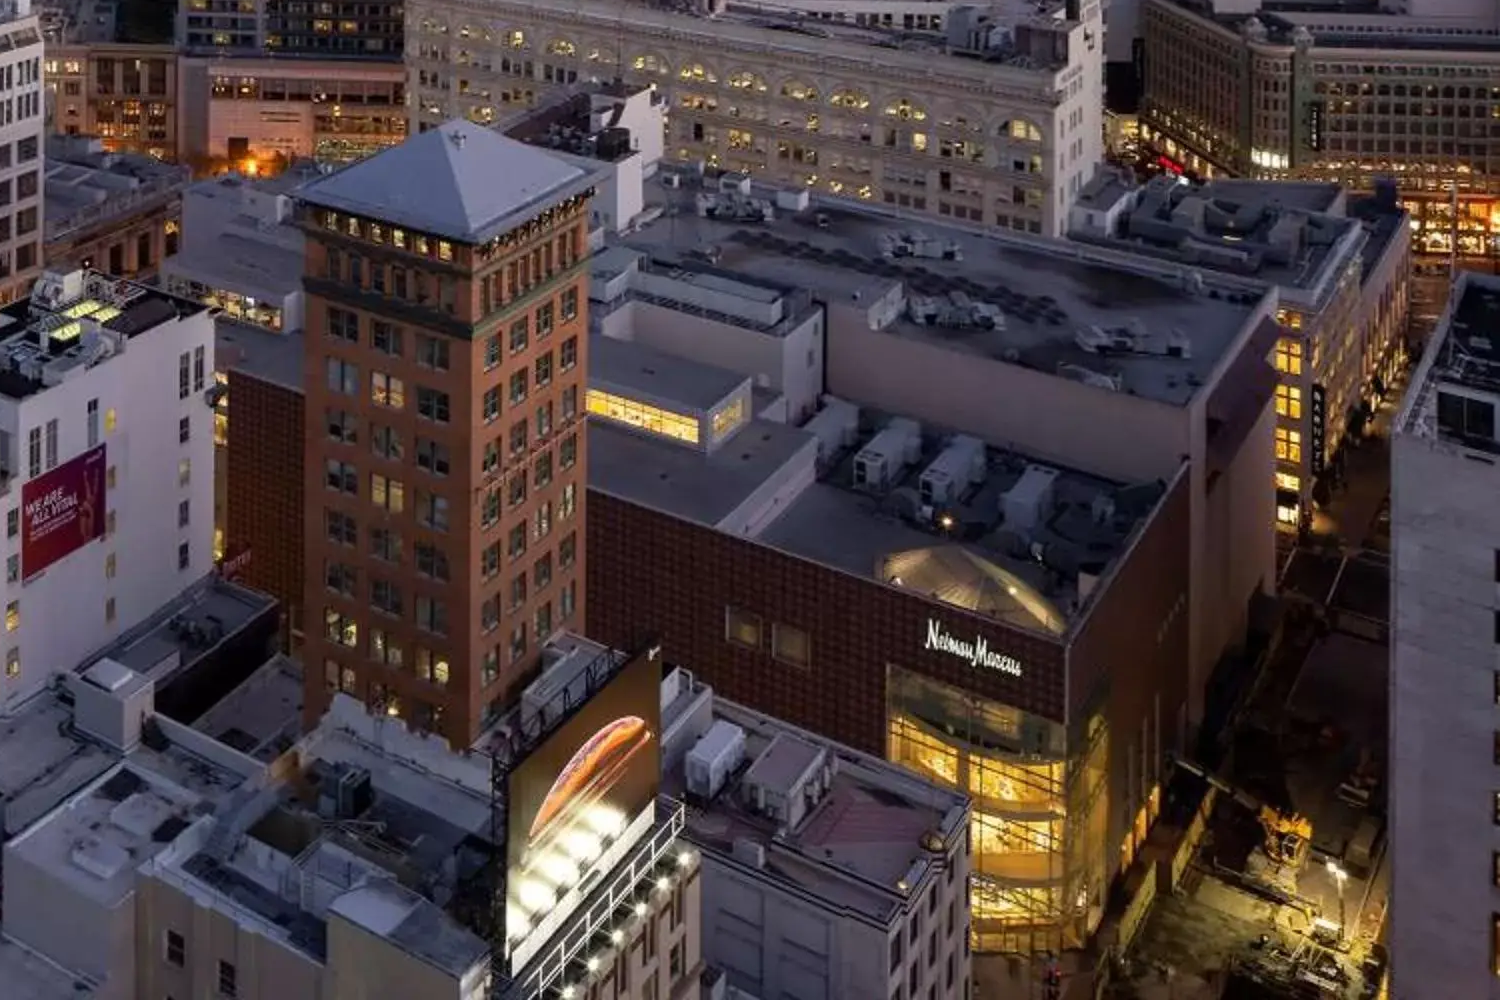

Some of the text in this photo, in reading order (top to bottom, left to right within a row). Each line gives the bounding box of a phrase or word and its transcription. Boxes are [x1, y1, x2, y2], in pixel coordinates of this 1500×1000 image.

[25, 486, 64, 516] WE ARE
[925, 618, 1022, 677] Neiman Marcus
